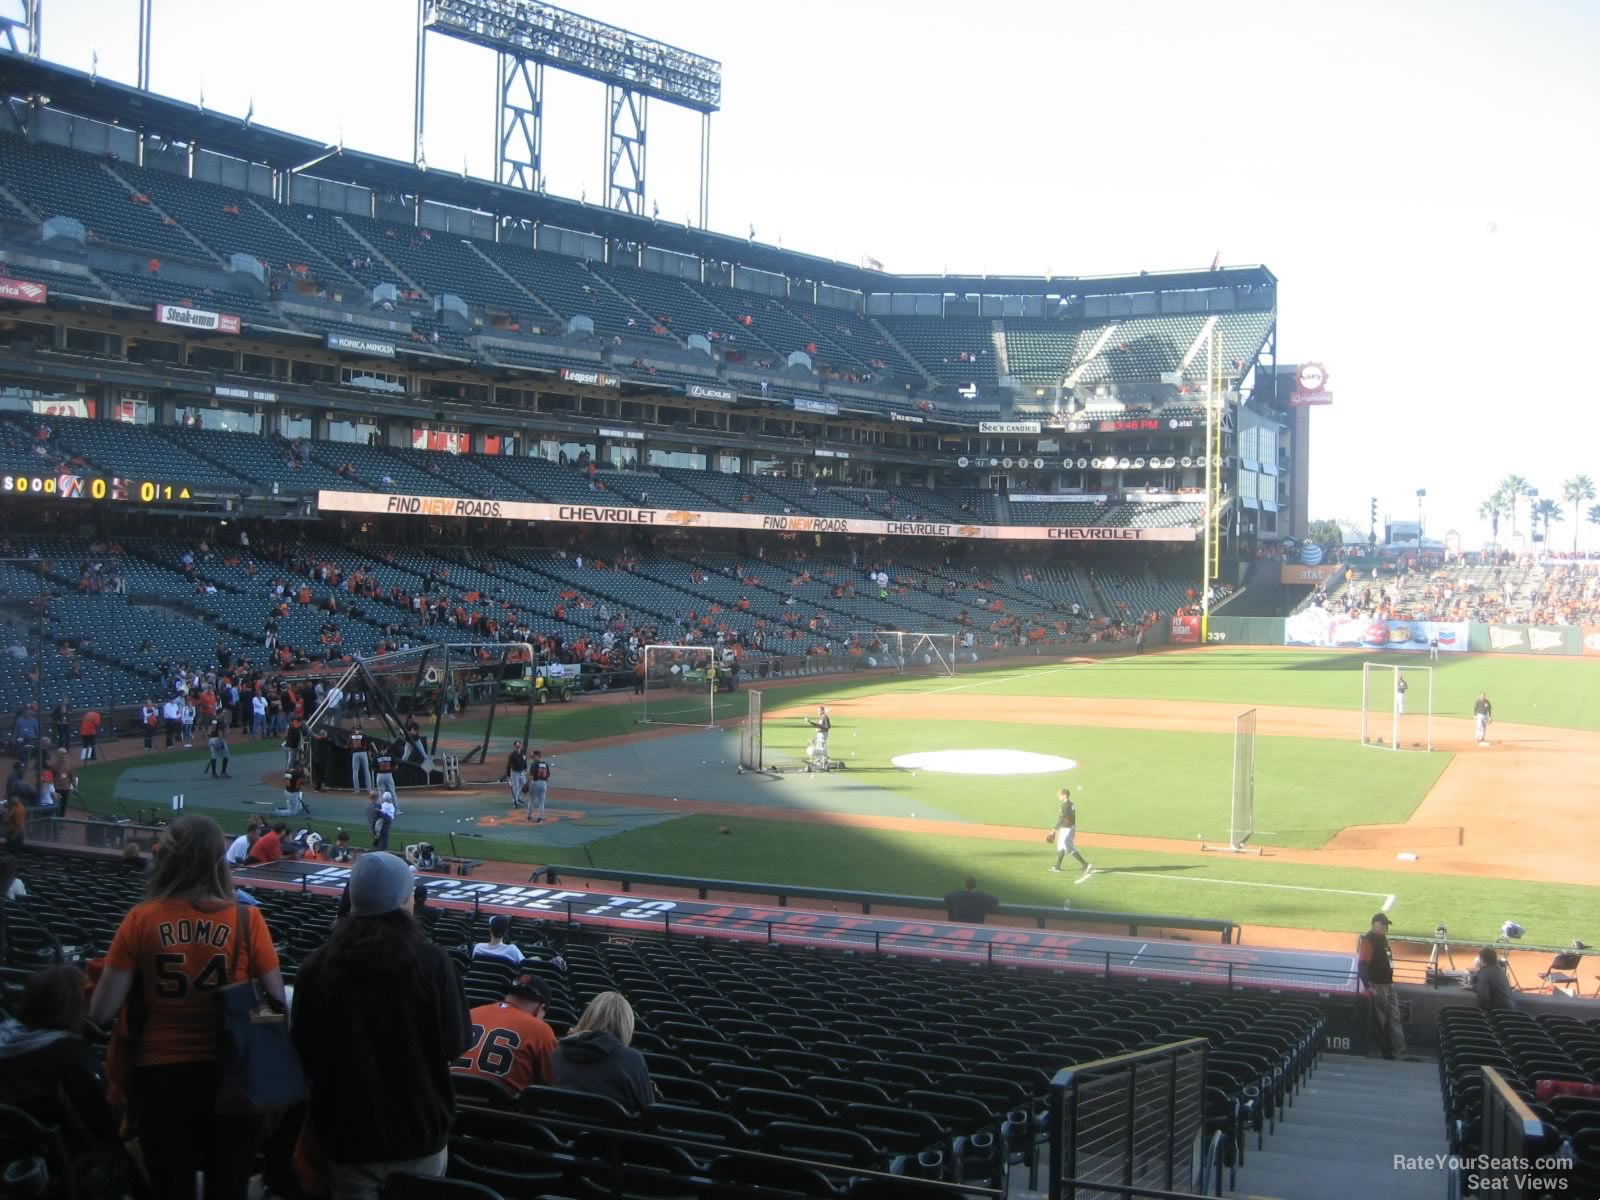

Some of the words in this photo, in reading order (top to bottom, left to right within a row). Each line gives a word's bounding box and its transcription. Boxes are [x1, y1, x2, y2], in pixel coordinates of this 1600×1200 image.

[166, 308, 215, 327] Steak-umm
[339, 338, 365, 350] KONICA
[366, 343, 394, 354] MINOLTA
[564, 370, 598, 384] Leapset
[702, 390, 731, 399] LEXUS
[981, 423, 1004, 432] See's
[387, 496, 420, 512] FIND
[422, 499, 454, 514] NEW
[455, 500, 502, 517] ROADS.
[559, 506, 656, 523] CHEVROLET
[763, 516, 787, 529] FIND
[789, 517, 812, 530] NEW
[813, 518, 849, 532] ROADS.
[887, 521, 951, 536] CHEVROLET
[1047, 528, 1143, 540] CHEVROLET
[1172, 617, 1182, 626] FLY
[1207, 632, 1226, 641] 339
[586, 896, 677, 919] TO
[158, 918, 231, 948] ROMO
[882, 924, 1082, 960] PARK
[155, 953, 228, 998] 54
[1326, 1036, 1350, 1050] 108
